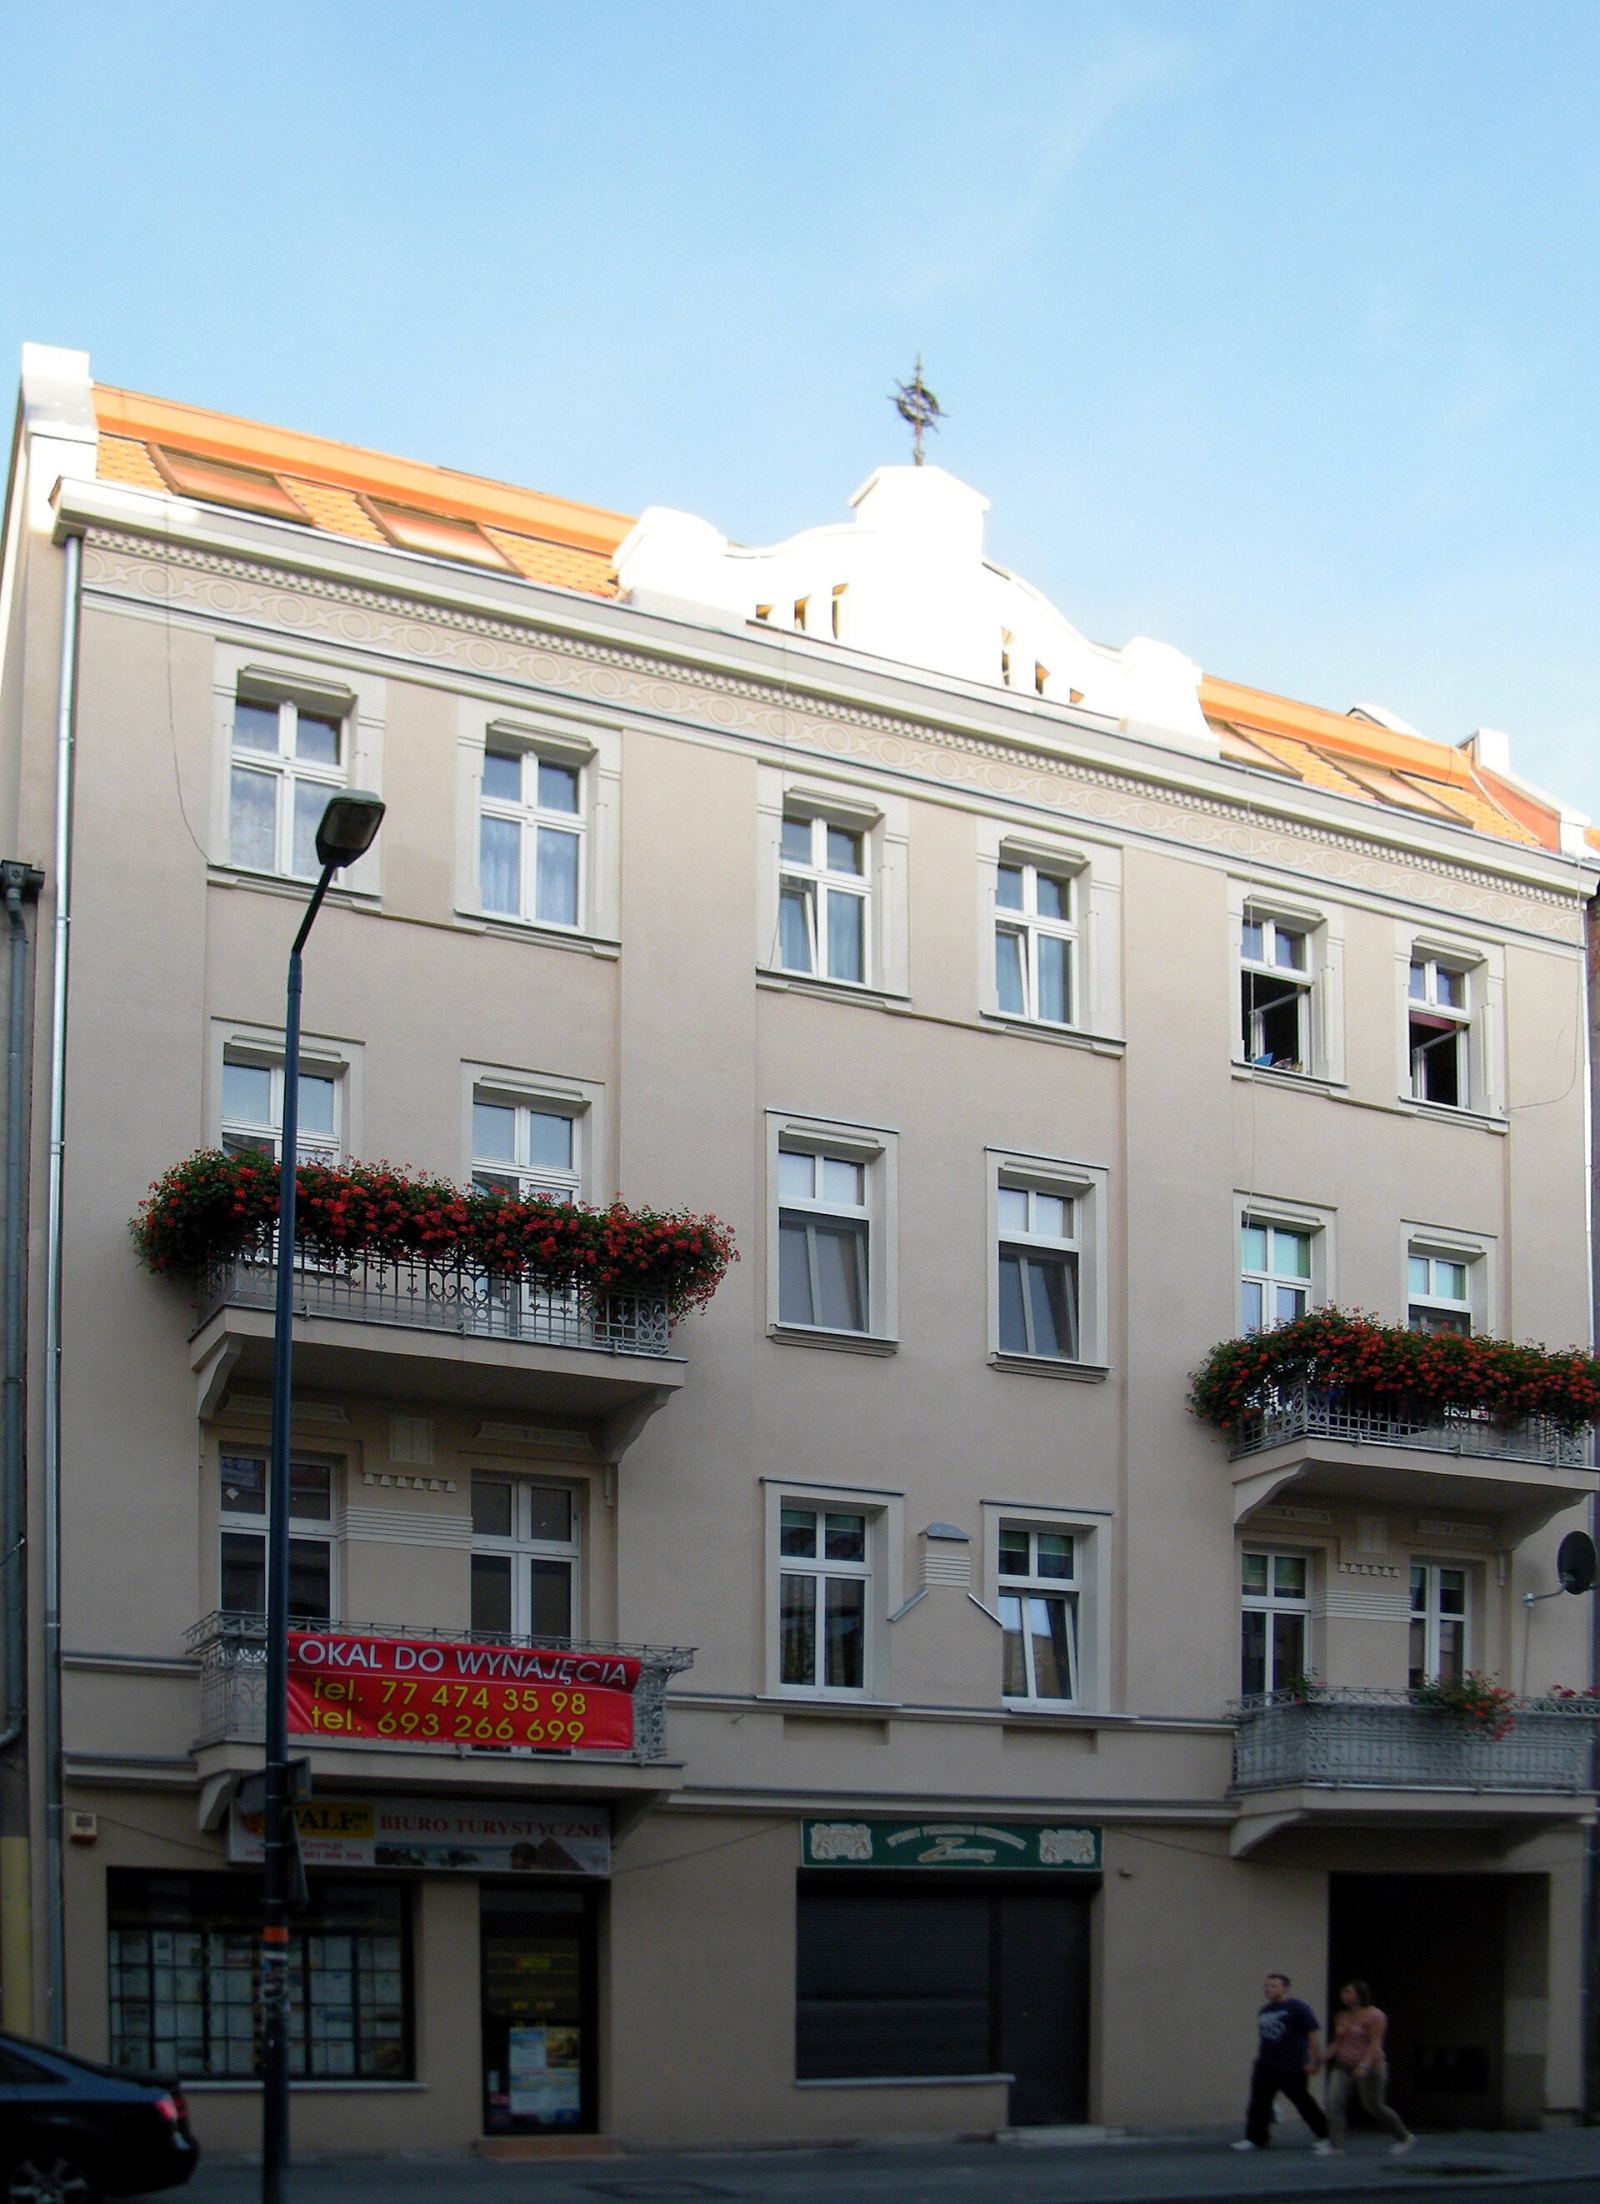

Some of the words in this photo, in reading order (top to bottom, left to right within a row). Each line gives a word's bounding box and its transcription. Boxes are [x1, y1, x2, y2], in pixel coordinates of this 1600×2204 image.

[394, 1646, 445, 1673] DO
[456, 1650, 627, 1686] WYNAJĘCIA
[313, 1677, 363, 1702] tel.
[382, 1681, 418, 1705] 77
[431, 1684, 490, 1709] 474
[502, 1688, 540, 1713] 35
[551, 1691, 587, 1716] 98
[312, 1706, 363, 1732] tel.
[377, 1711, 440, 1737] 693
[453, 1715, 515, 1740] 266
[526, 1719, 586, 1744] 699
[380, 1815, 449, 1833] BIURO
[455, 1818, 603, 1839] TURYSTYCZNE
